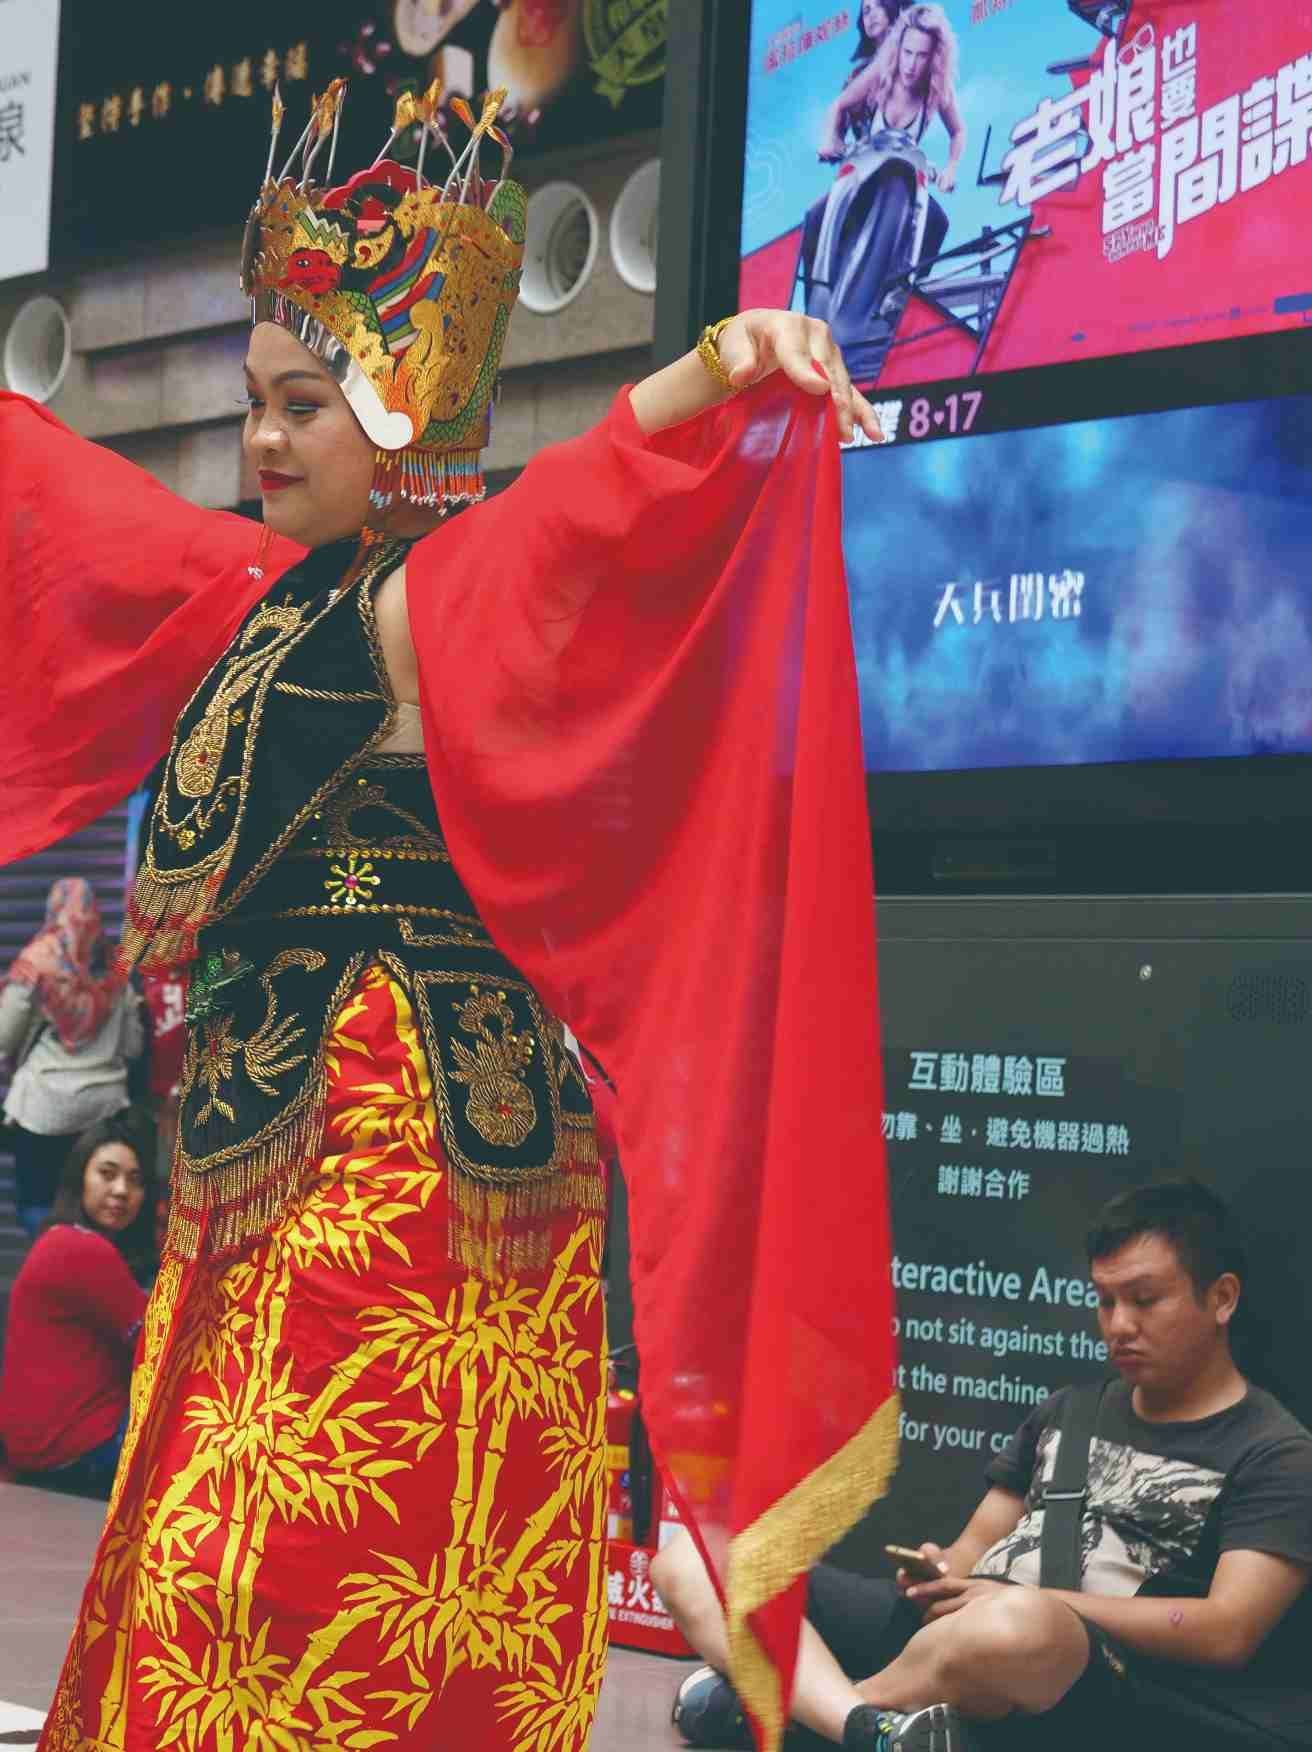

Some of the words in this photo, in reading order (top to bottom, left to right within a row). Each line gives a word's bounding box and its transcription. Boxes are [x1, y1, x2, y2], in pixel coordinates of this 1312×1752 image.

[907, 1051, 1067, 1097] 互動體驗區
[938, 1164, 1030, 1200] 謝謝合作
[891, 1256, 1022, 1300] teractive
[1028, 1267, 1101, 1309] Area
[906, 1316, 943, 1342] not
[948, 1317, 976, 1346] sit
[980, 1325, 1065, 1357] against
[1070, 1331, 1109, 1362] the
[911, 1364, 948, 1394] the
[952, 1374, 1049, 1405] machine
[897, 1412, 929, 1441] for
[932, 1423, 985, 1451] your
